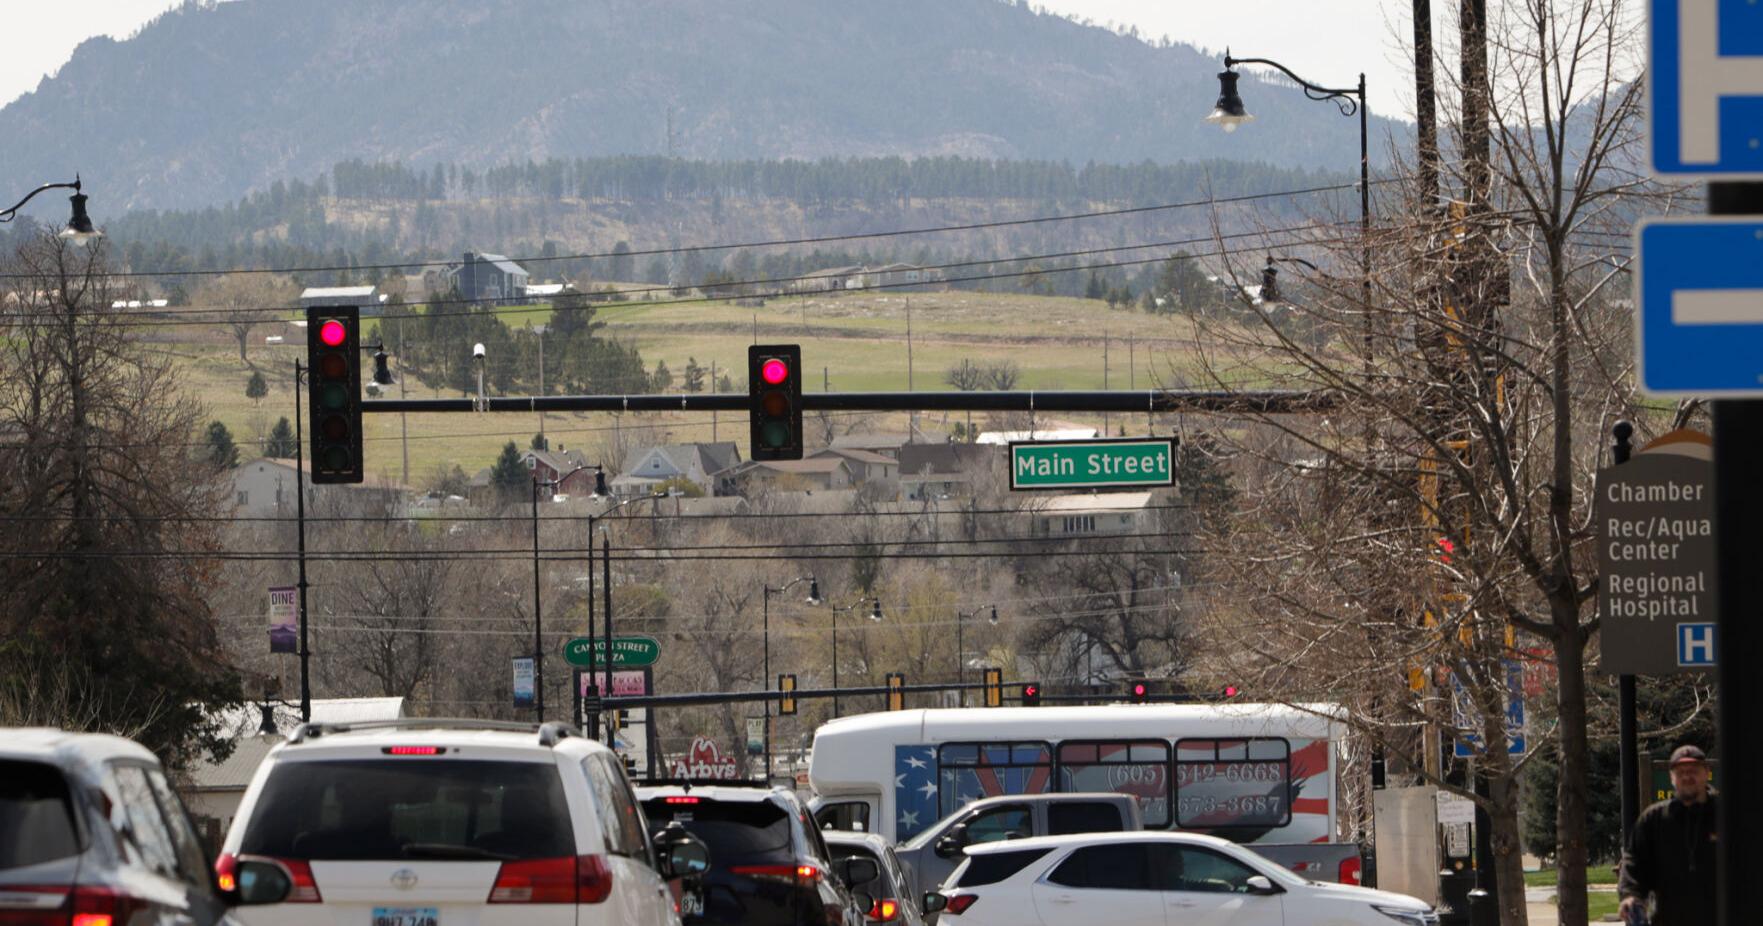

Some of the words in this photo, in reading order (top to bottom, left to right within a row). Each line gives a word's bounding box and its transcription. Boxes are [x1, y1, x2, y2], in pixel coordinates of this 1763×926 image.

[1018, 453, 1074, 476] Main
[1088, 452, 1166, 475] Street
[1608, 481, 1704, 502] Chamber
[1608, 517, 1711, 541] Rec/Aqua
[1609, 541, 1679, 560] Center
[1609, 571, 1705, 598] Regional
[271, 592, 295, 605] DINE
[1610, 594, 1698, 621] Hospital
[617, 642, 650, 653] STREET
[1685, 627, 1713, 661] H
[595, 653, 625, 662] PLZA
